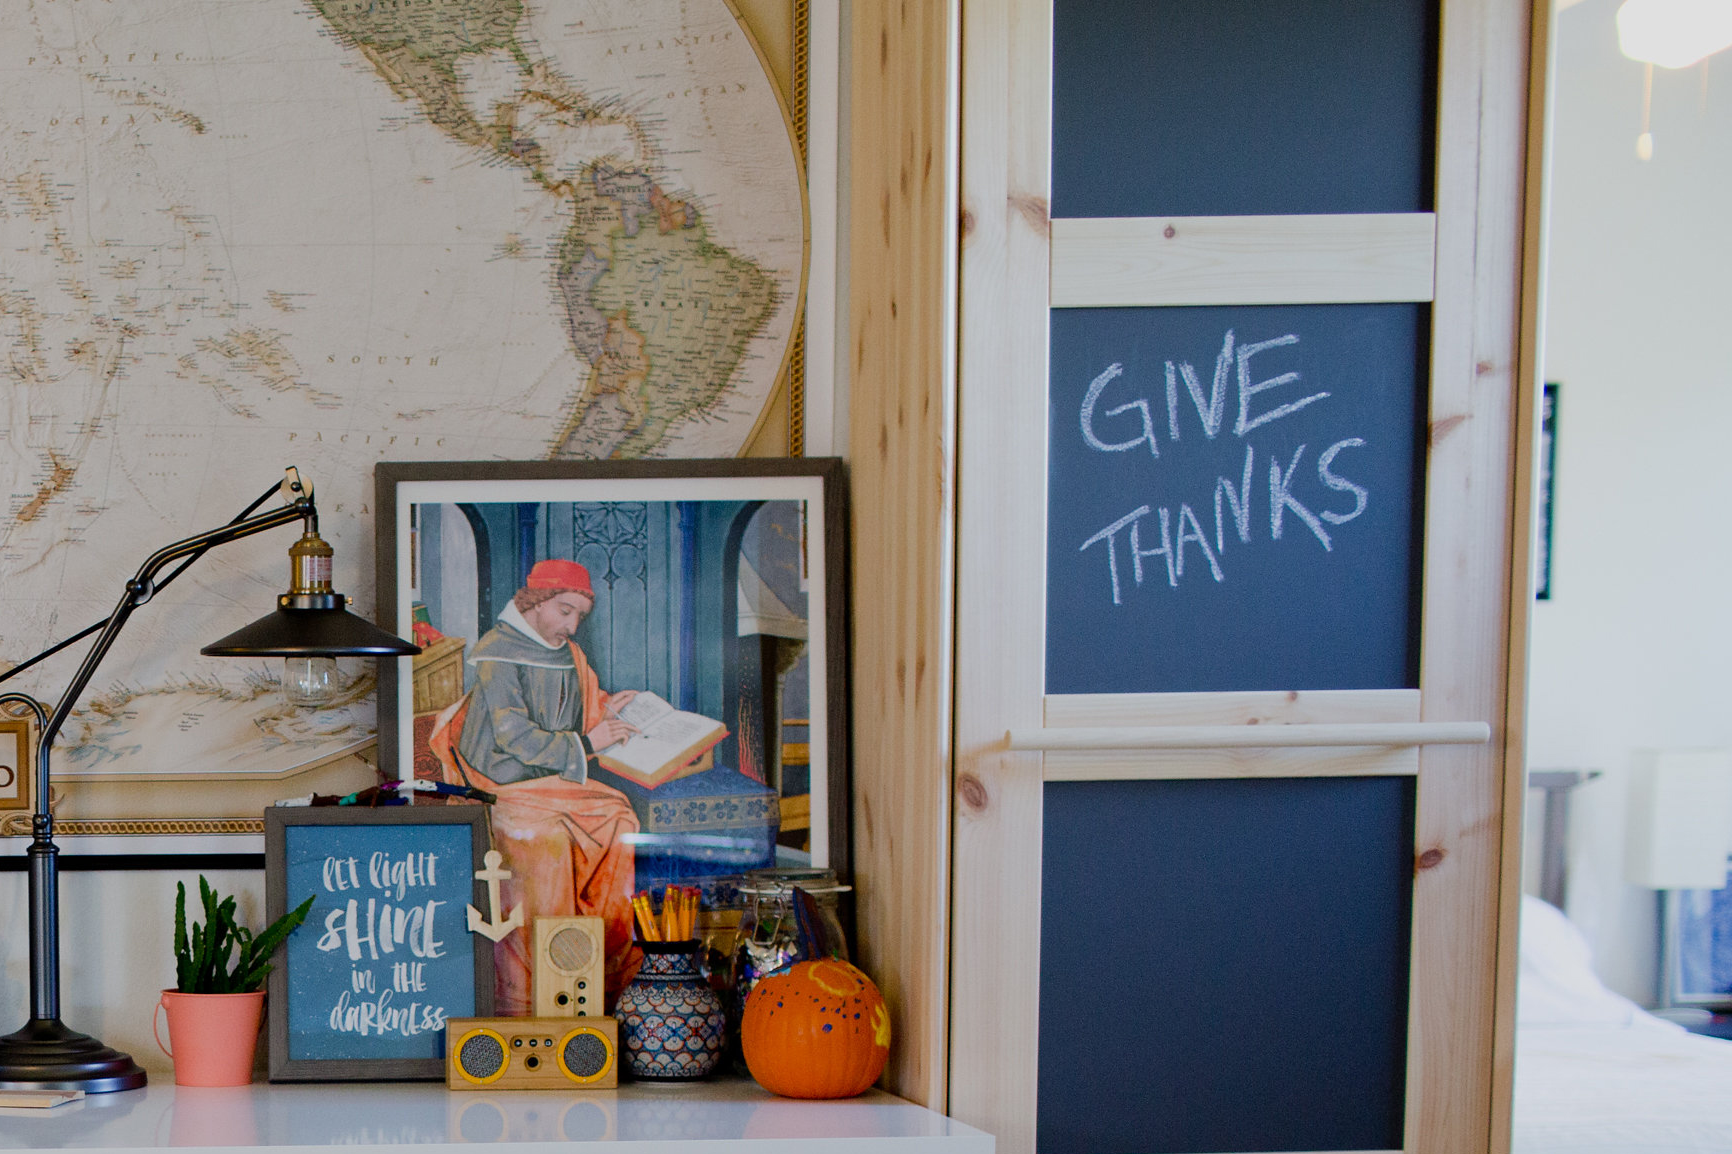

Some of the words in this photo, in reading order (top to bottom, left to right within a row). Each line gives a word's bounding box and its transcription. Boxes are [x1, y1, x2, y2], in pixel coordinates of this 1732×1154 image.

[27, 51, 184, 66] PACIFIC
[48, 113, 163, 126] OCEAN
[327, 352, 440, 367] SOUTH
[1079, 328, 1332, 459] GIVE
[288, 431, 446, 447] PACIFIC
[1079, 437, 1369, 605] THANKS
